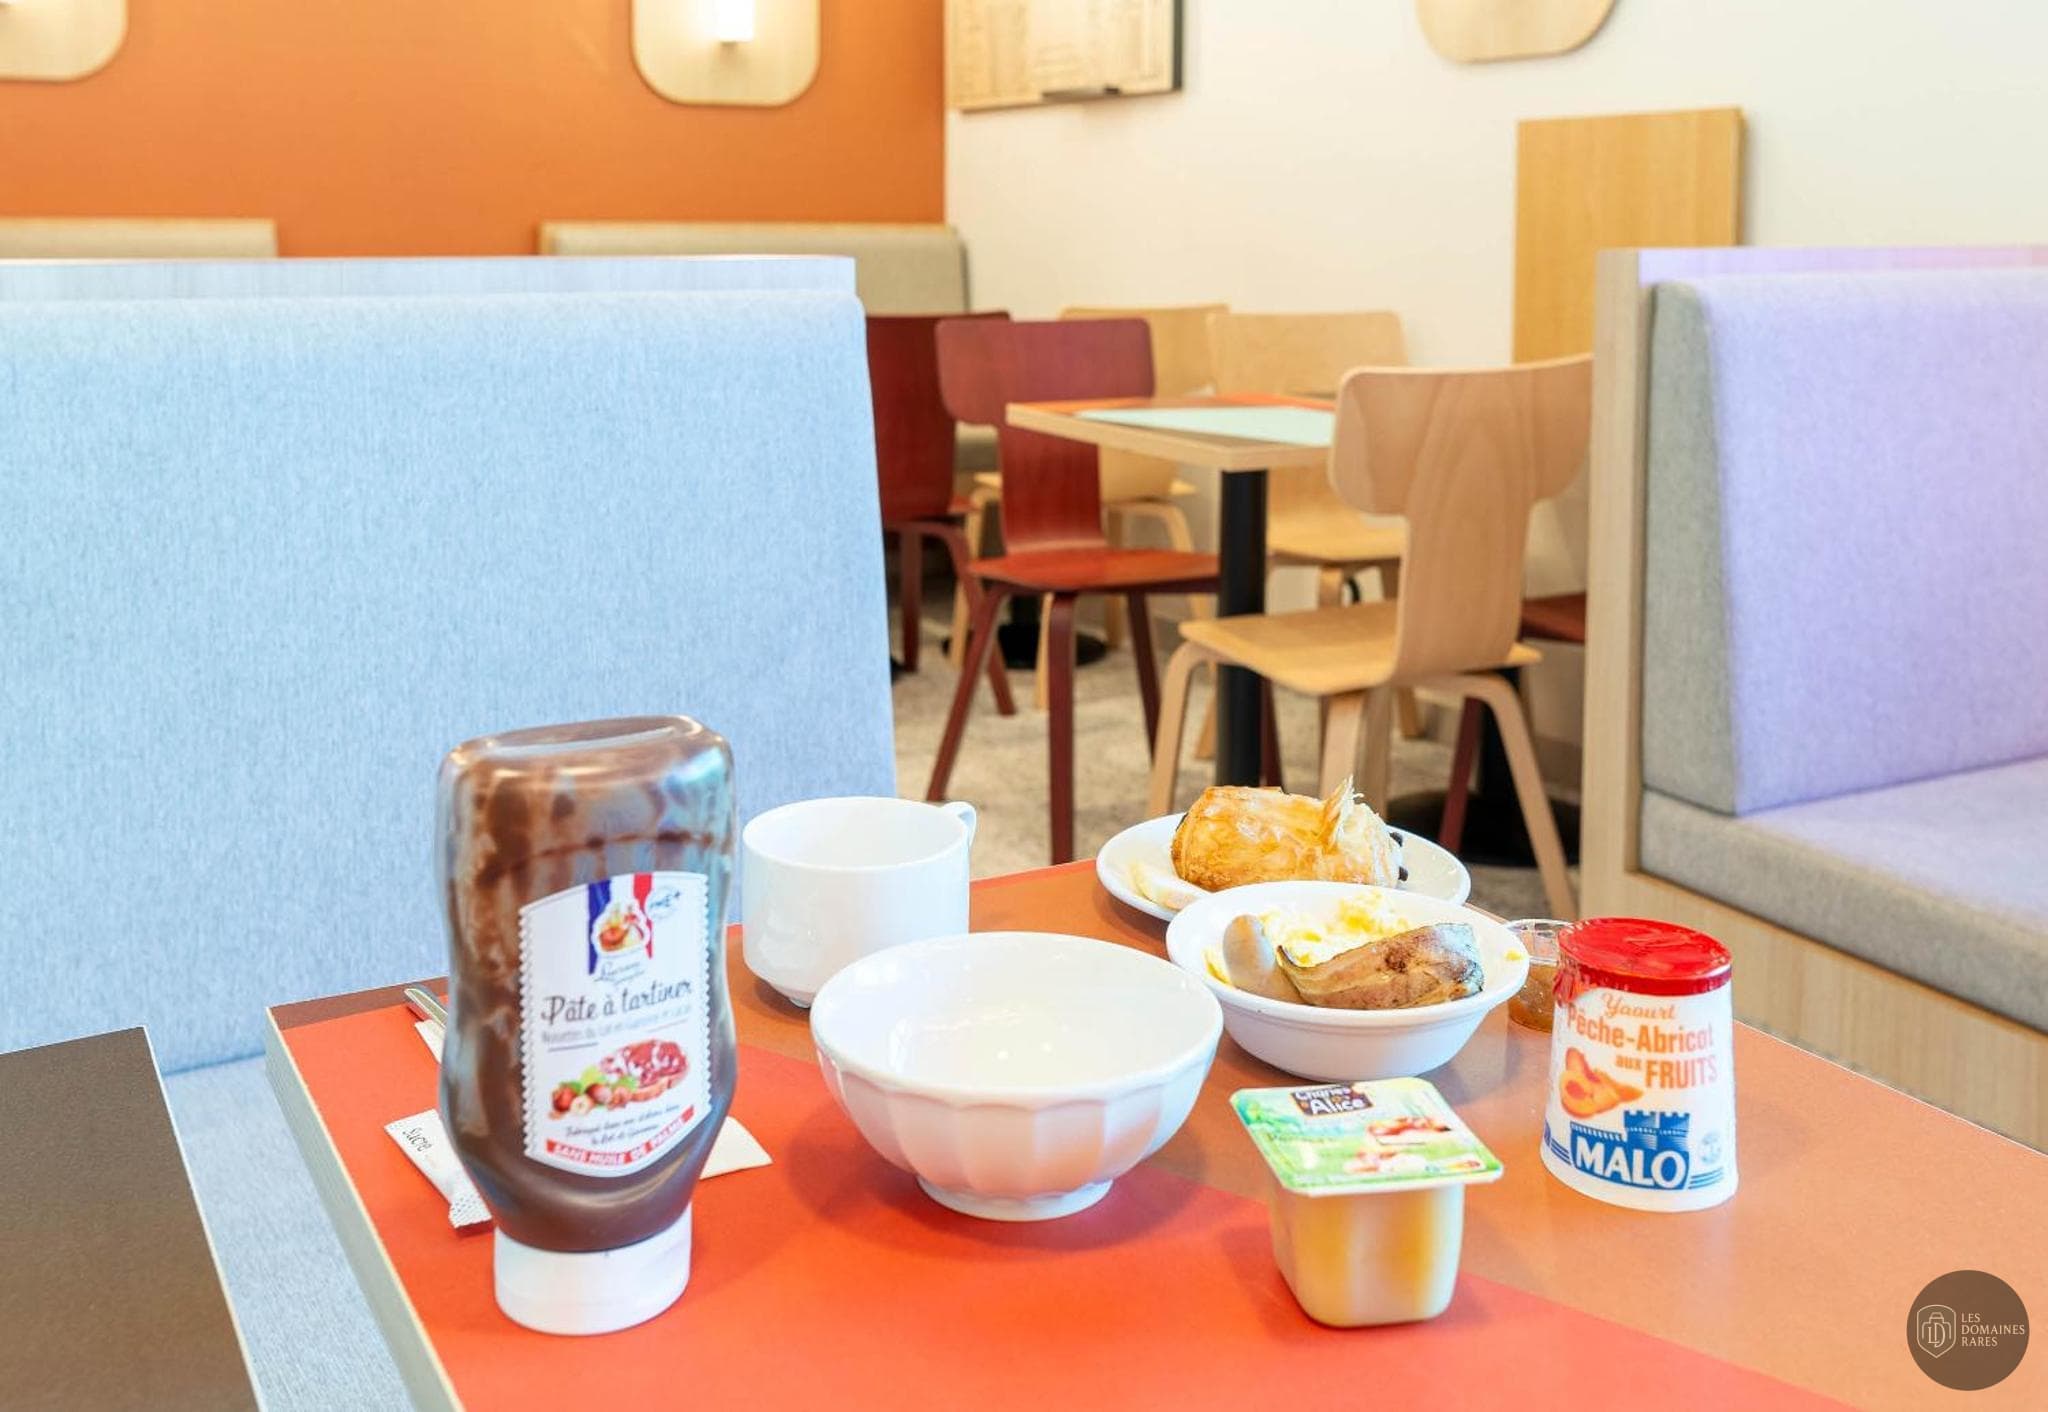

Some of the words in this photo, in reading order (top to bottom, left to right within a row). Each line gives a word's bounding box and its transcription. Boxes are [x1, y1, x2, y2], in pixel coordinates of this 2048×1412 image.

[541, 995, 597, 1025] Pâte
[603, 994, 615, 1016] à
[622, 980, 691, 1013] tartiner
[1602, 992, 1678, 1020] Yaourt
[1615, 1055, 1641, 1071] aux
[1645, 1055, 1717, 1089] FRUITS
[1310, 1097, 1366, 1116] Alice
[1576, 1135, 1687, 1189] MALO
